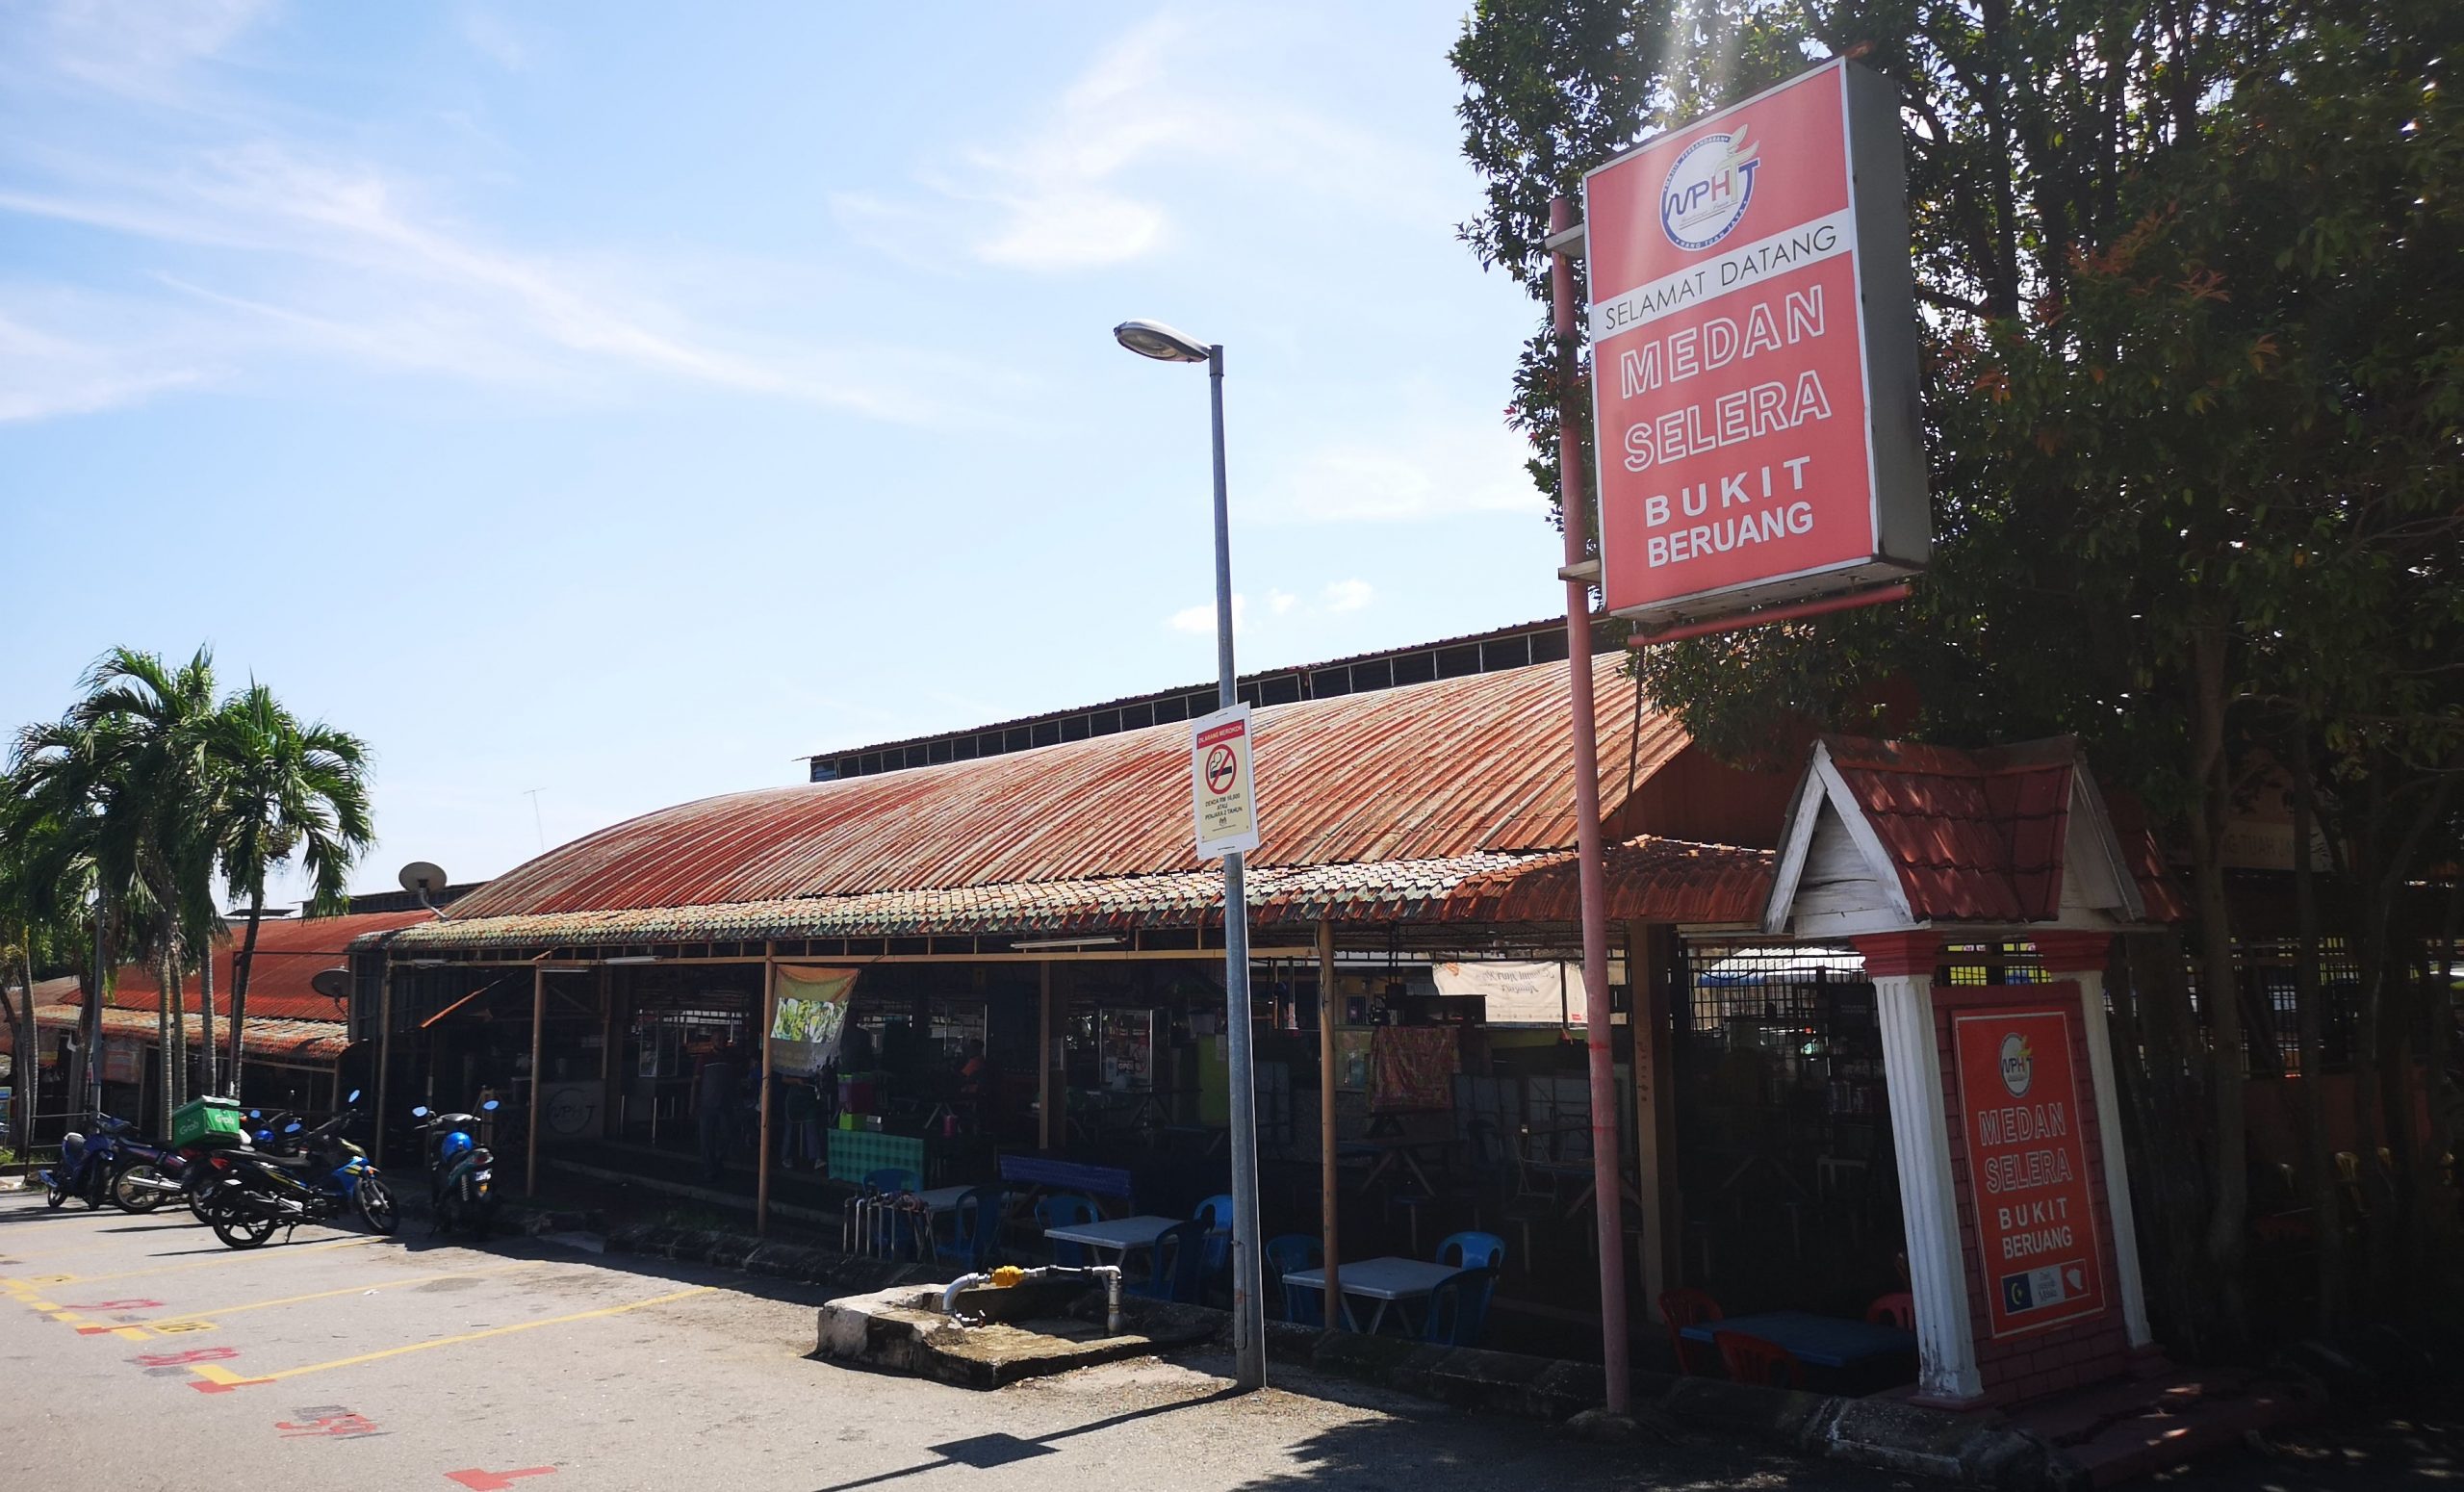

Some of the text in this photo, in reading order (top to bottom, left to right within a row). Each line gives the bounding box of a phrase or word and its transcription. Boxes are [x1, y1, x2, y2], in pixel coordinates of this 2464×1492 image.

[1605, 225, 1836, 331] SELAMAT DATANG
[1621, 285, 1826, 399] MEDAN
[1624, 370, 1832, 473] SELERA
[1646, 456, 1810, 527] BUKIT
[1648, 501, 1814, 569] BERUANG
[179, 1119, 200, 1135] Grab
[215, 1114, 235, 1125] Grab
[1978, 1101, 2066, 1146] MEDAN
[1984, 1147, 2074, 1194] SELERA
[1998, 1196, 2068, 1231] BUKIT
[2001, 1225, 2073, 1260] BERUANG
